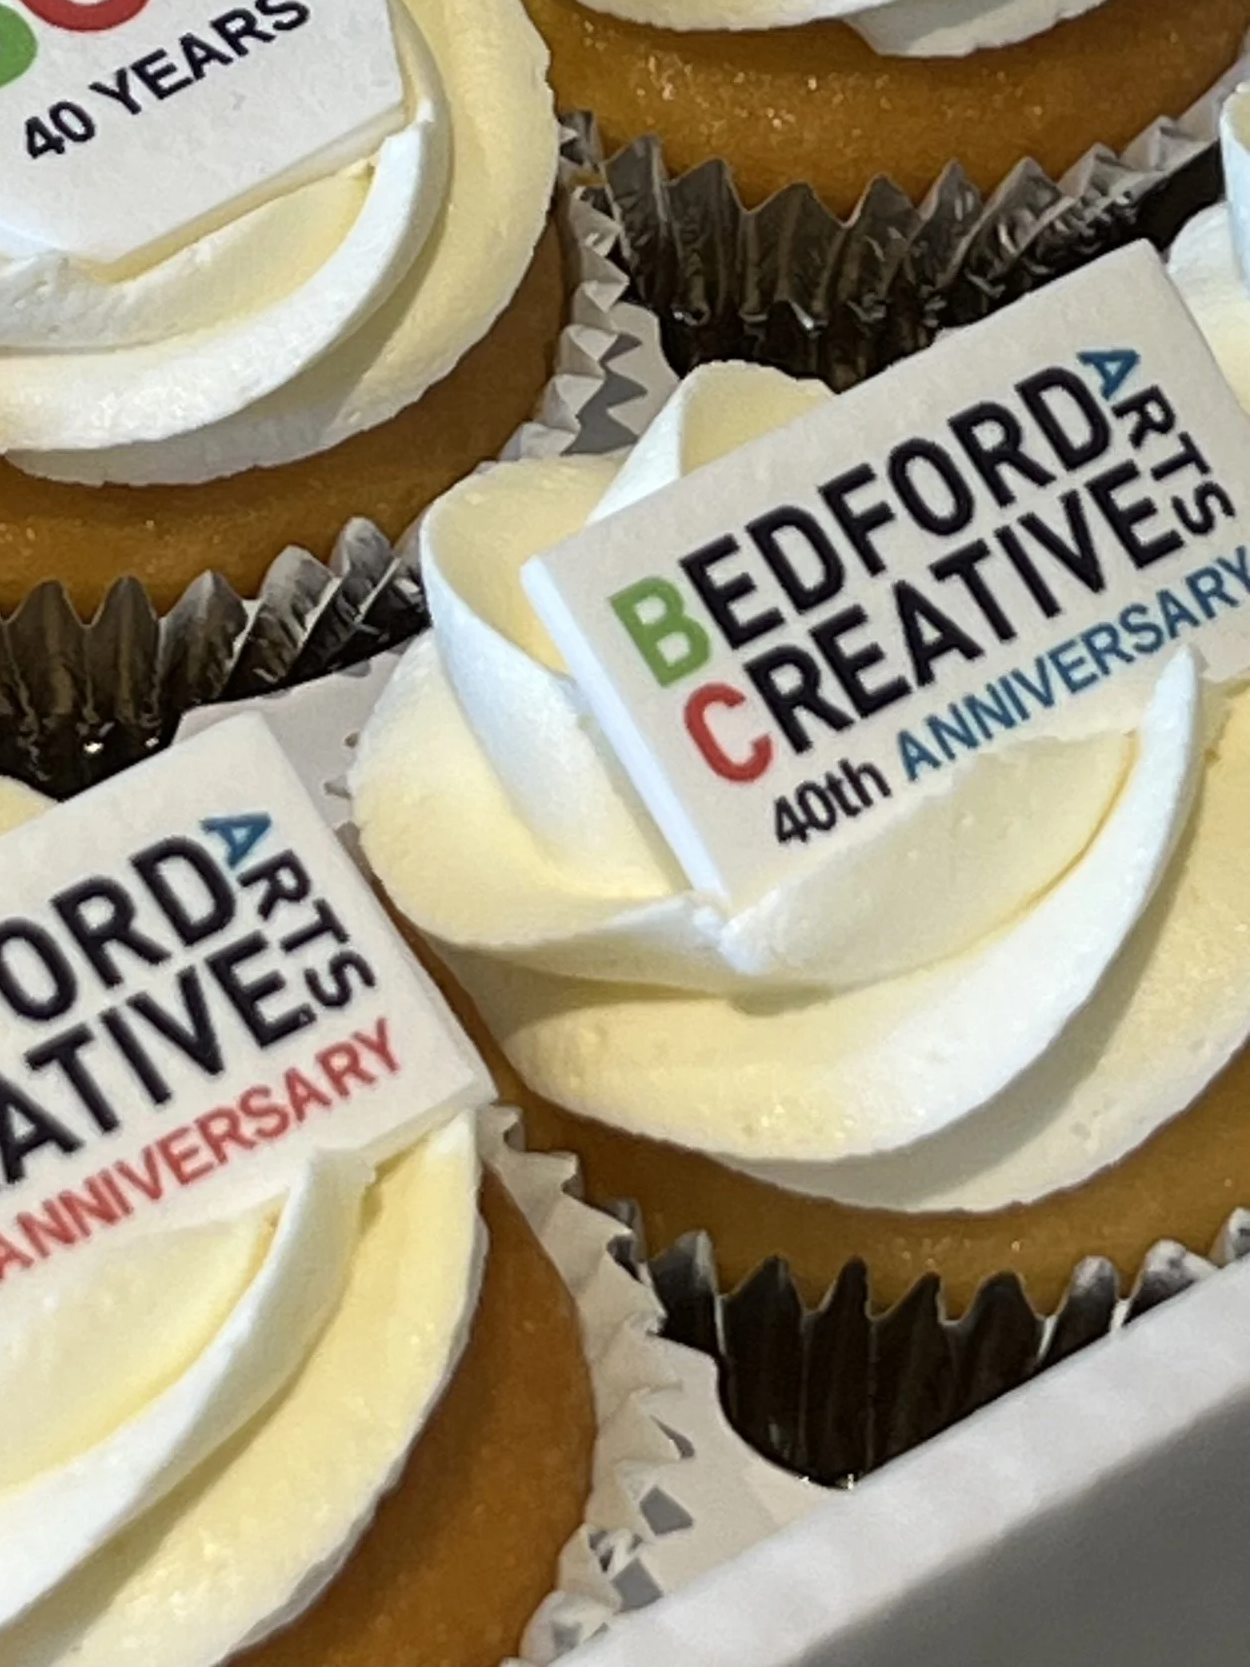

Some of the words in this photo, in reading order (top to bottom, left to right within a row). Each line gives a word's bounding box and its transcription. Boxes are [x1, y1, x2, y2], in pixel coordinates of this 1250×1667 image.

[22, 99, 98, 160] 40
[609, 365, 1112, 690] BEDFORD
[1077, 347, 1236, 537] ARTS
[683, 458, 1186, 784] CREATIVE
[773, 759, 892, 845] 40th
[896, 546, 1250, 782] ANNIVERSARY
[201, 810, 377, 1012] ARTS
